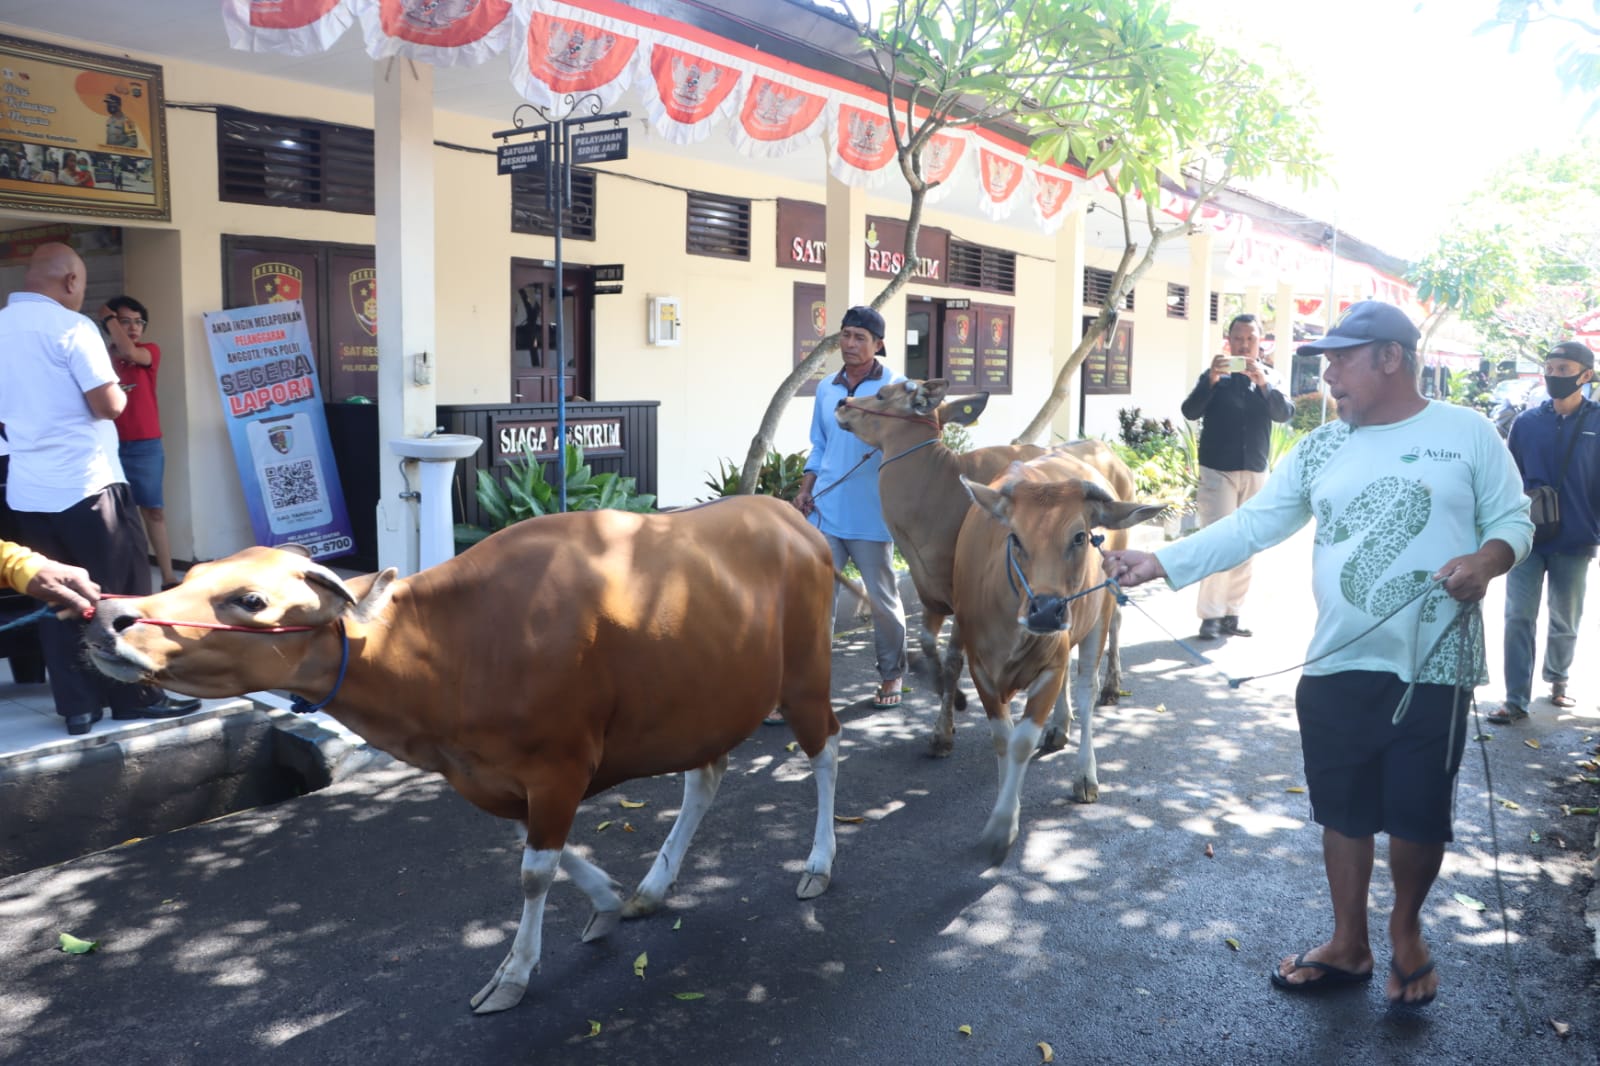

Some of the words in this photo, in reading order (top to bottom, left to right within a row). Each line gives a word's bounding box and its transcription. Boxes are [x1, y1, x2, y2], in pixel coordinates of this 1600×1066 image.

[575, 132, 622, 146] PELAYANAN
[503, 145, 536, 156] SATUAN
[577, 144, 600, 155] SIDIK
[601, 142, 620, 152] JARI
[500, 154, 538, 166] RESKRIM
[212, 322, 233, 334] ANDA
[233, 317, 254, 330] INGIN
[254, 311, 302, 328] MELAPORKAN
[234, 329, 286, 346] PELANGGARAN
[279, 342, 300, 356] POLRI
[343, 345, 360, 357] SAT
[221, 354, 313, 395] SEGERA
[229, 377, 315, 418] LAPOR!
[500, 426, 547, 454] SIAGA
[1423, 448, 1462, 459] Avian
